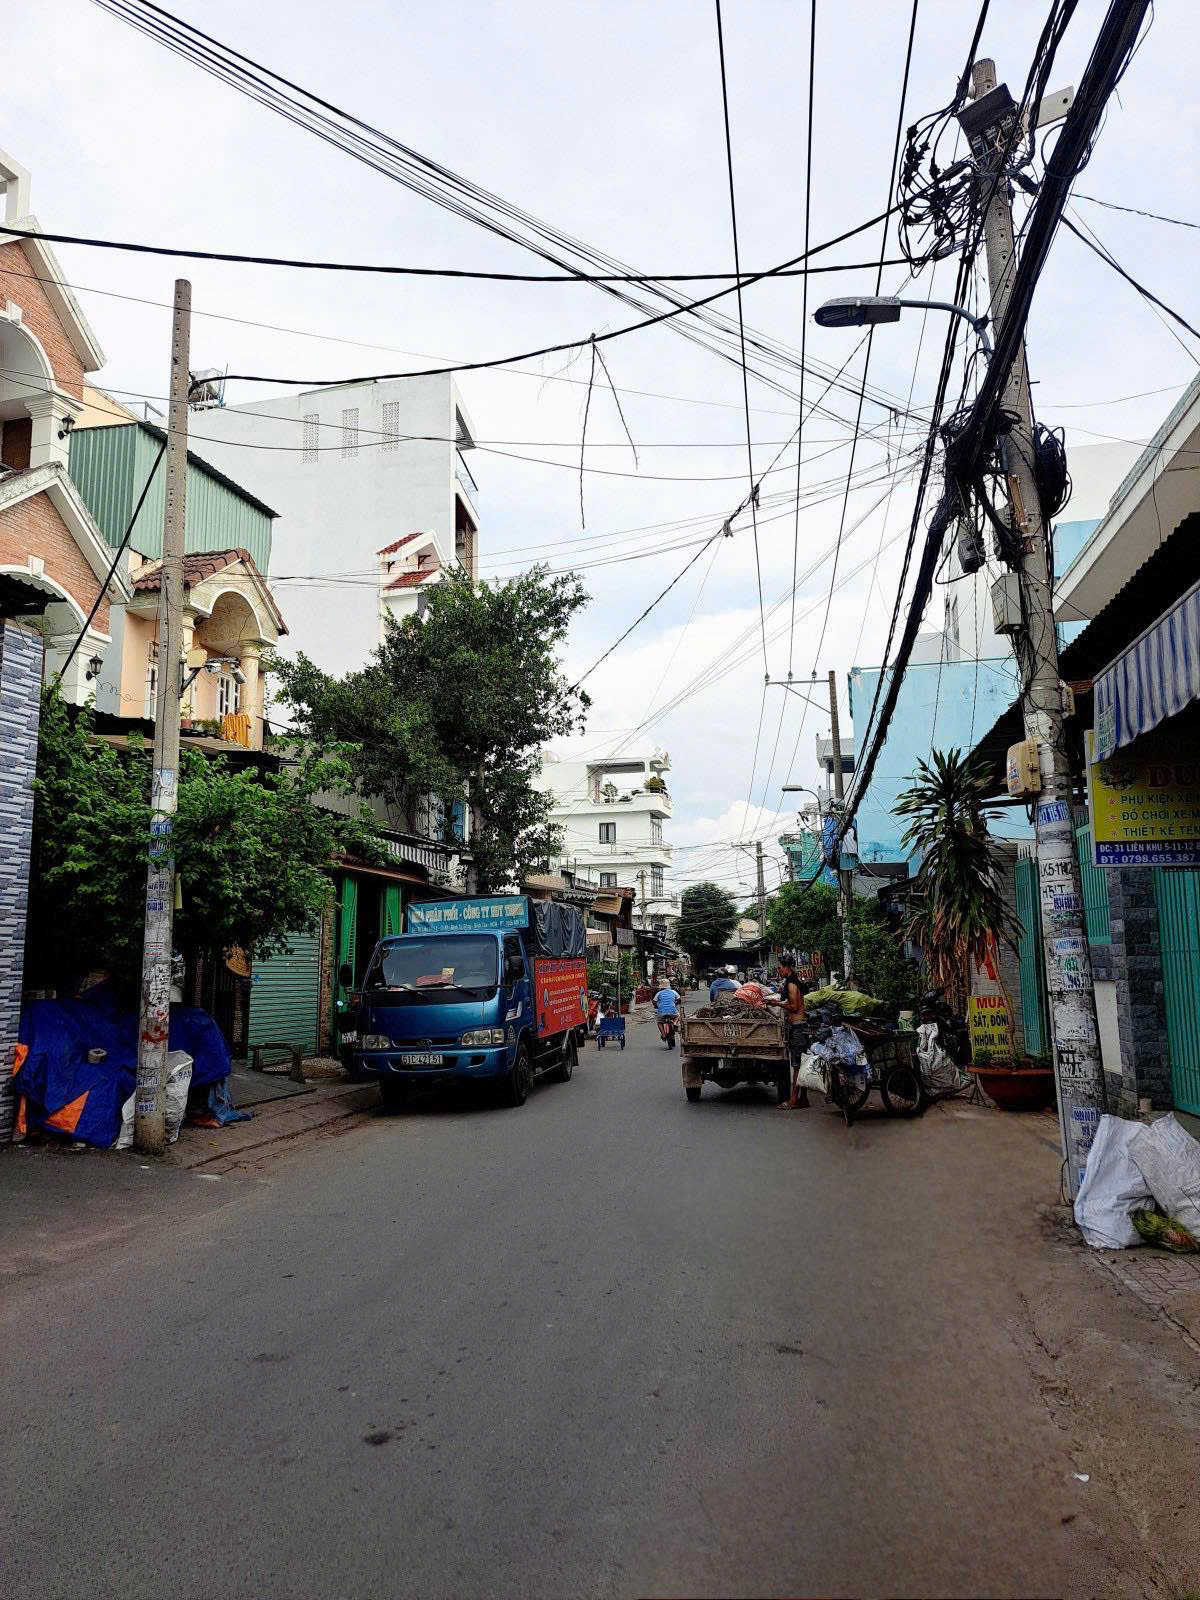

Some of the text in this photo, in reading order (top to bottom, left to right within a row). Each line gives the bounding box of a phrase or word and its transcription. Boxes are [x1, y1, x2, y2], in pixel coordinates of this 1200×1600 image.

[1122, 796, 1144, 805] PHỤ
[1143, 810, 1169, 820] CHƠI
[1174, 810, 1190, 818] XE
[1123, 824, 1154, 836] THIẾT
[1160, 823, 1176, 835] KẾ
[1099, 844, 1113, 853] ĐC:
[1114, 844, 1124, 852] 31
[1126, 842, 1145, 852] LIÊN
[1146, 843, 1162, 852] KHU
[1100, 853, 1196, 864] ĐT: 0798.655.387
[976, 996, 1006, 1009] MUA
